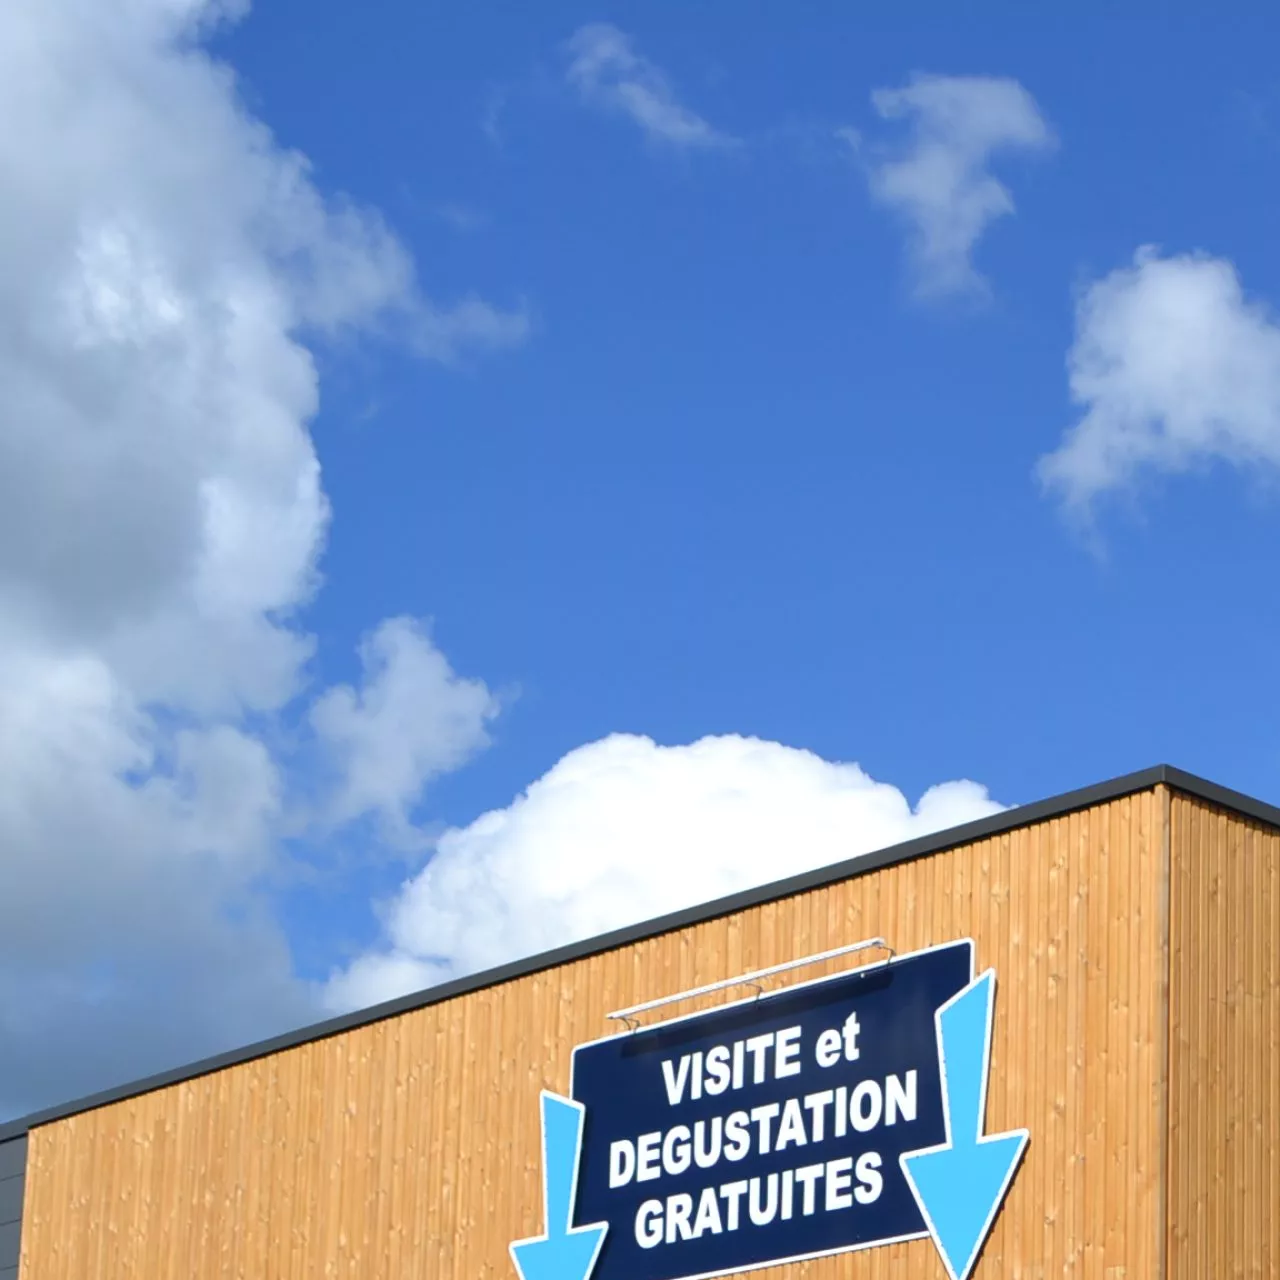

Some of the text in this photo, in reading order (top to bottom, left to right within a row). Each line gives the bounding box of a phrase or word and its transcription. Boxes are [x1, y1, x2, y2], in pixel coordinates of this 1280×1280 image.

[661, 1012, 861, 1106] VISITE et
[608, 1070, 918, 1189] DEGUSTATION
[634, 1151, 884, 1249] GRATUITES
